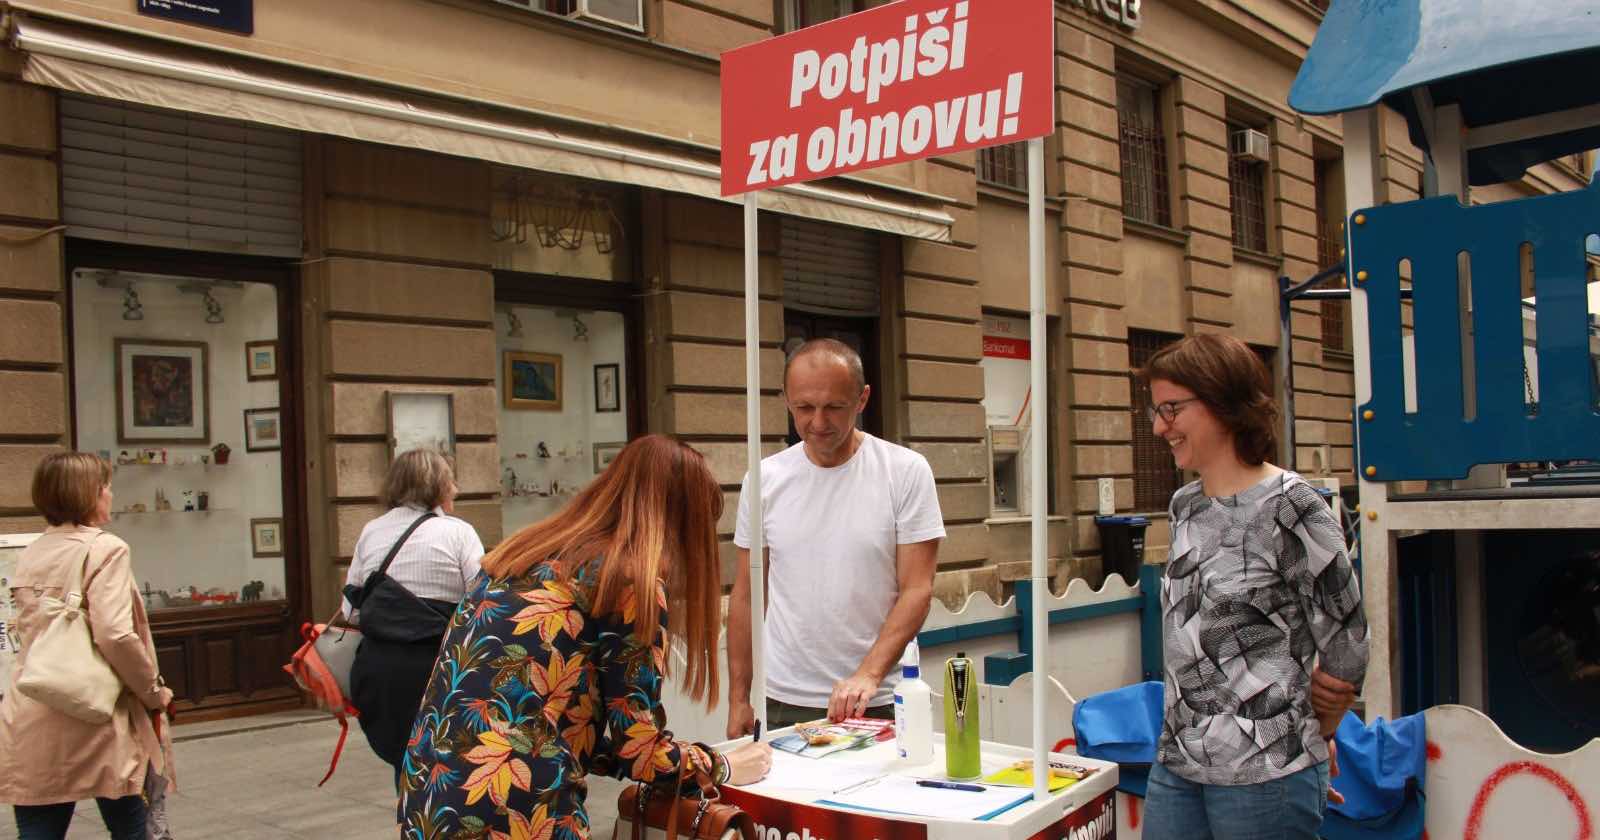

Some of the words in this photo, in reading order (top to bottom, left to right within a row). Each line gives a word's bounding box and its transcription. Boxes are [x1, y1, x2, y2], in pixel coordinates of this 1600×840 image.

[789, 0, 969, 108] Potpiši
[746, 133, 800, 185] za
[806, 71, 1023, 172] obnovu!
